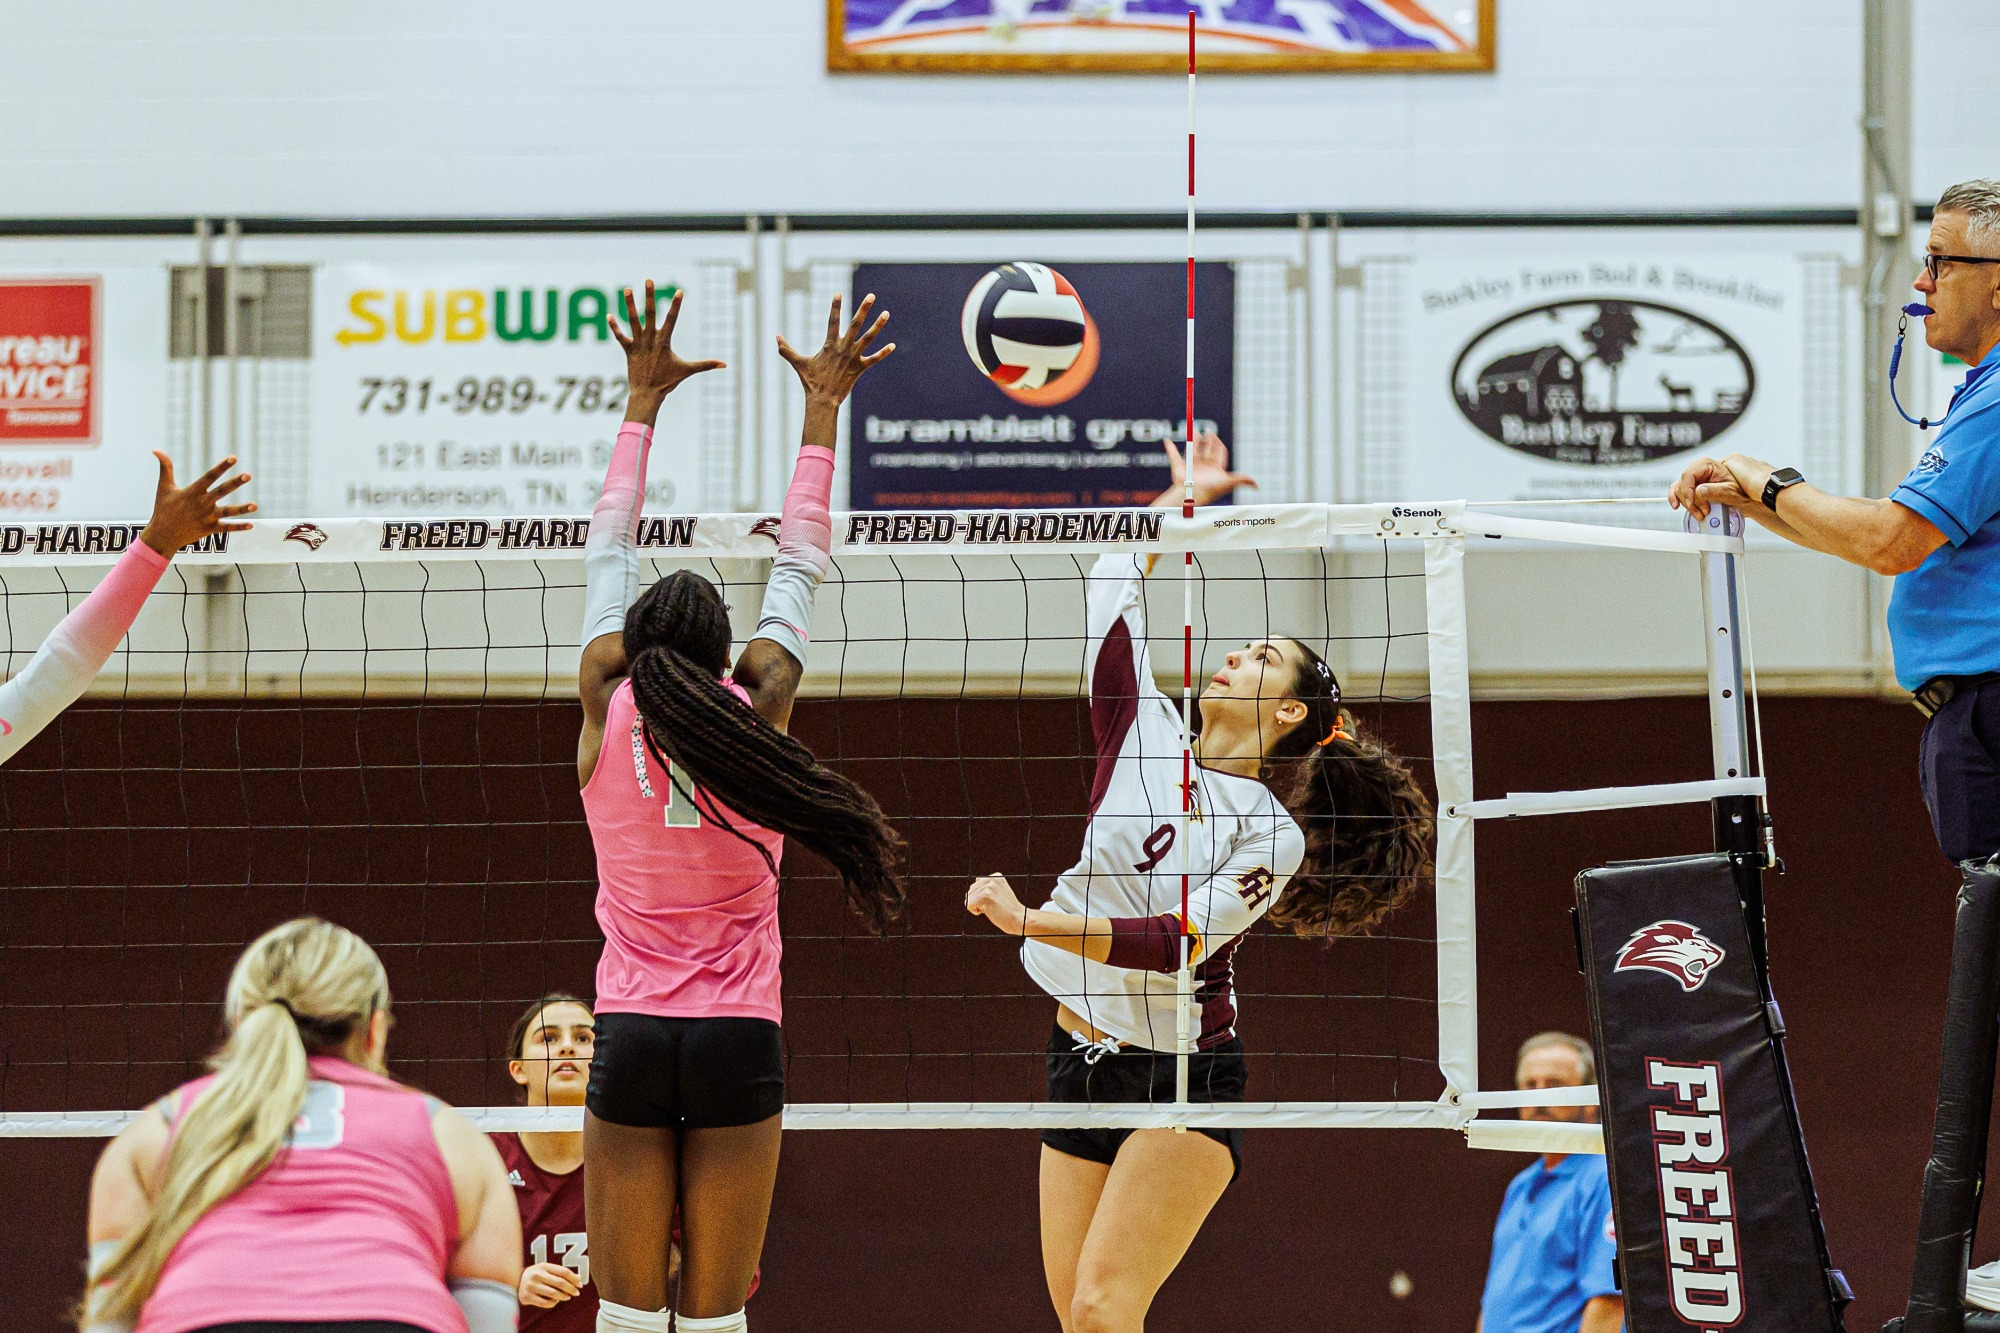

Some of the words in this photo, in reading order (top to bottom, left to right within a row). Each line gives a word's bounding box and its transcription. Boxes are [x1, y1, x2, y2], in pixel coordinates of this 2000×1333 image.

[0, 368, 89, 400] VICE
[356, 375, 631, 414] 731-989-782
[845, 513, 1165, 545] FREED-HARDEMAN
[1213, 518, 1241, 529] sports
[1403, 507, 1442, 518] Senoh
[379, 517, 698, 551] FREED-HARDAN
[1133, 823, 1177, 873] 9
[530, 1232, 590, 1286] 13
